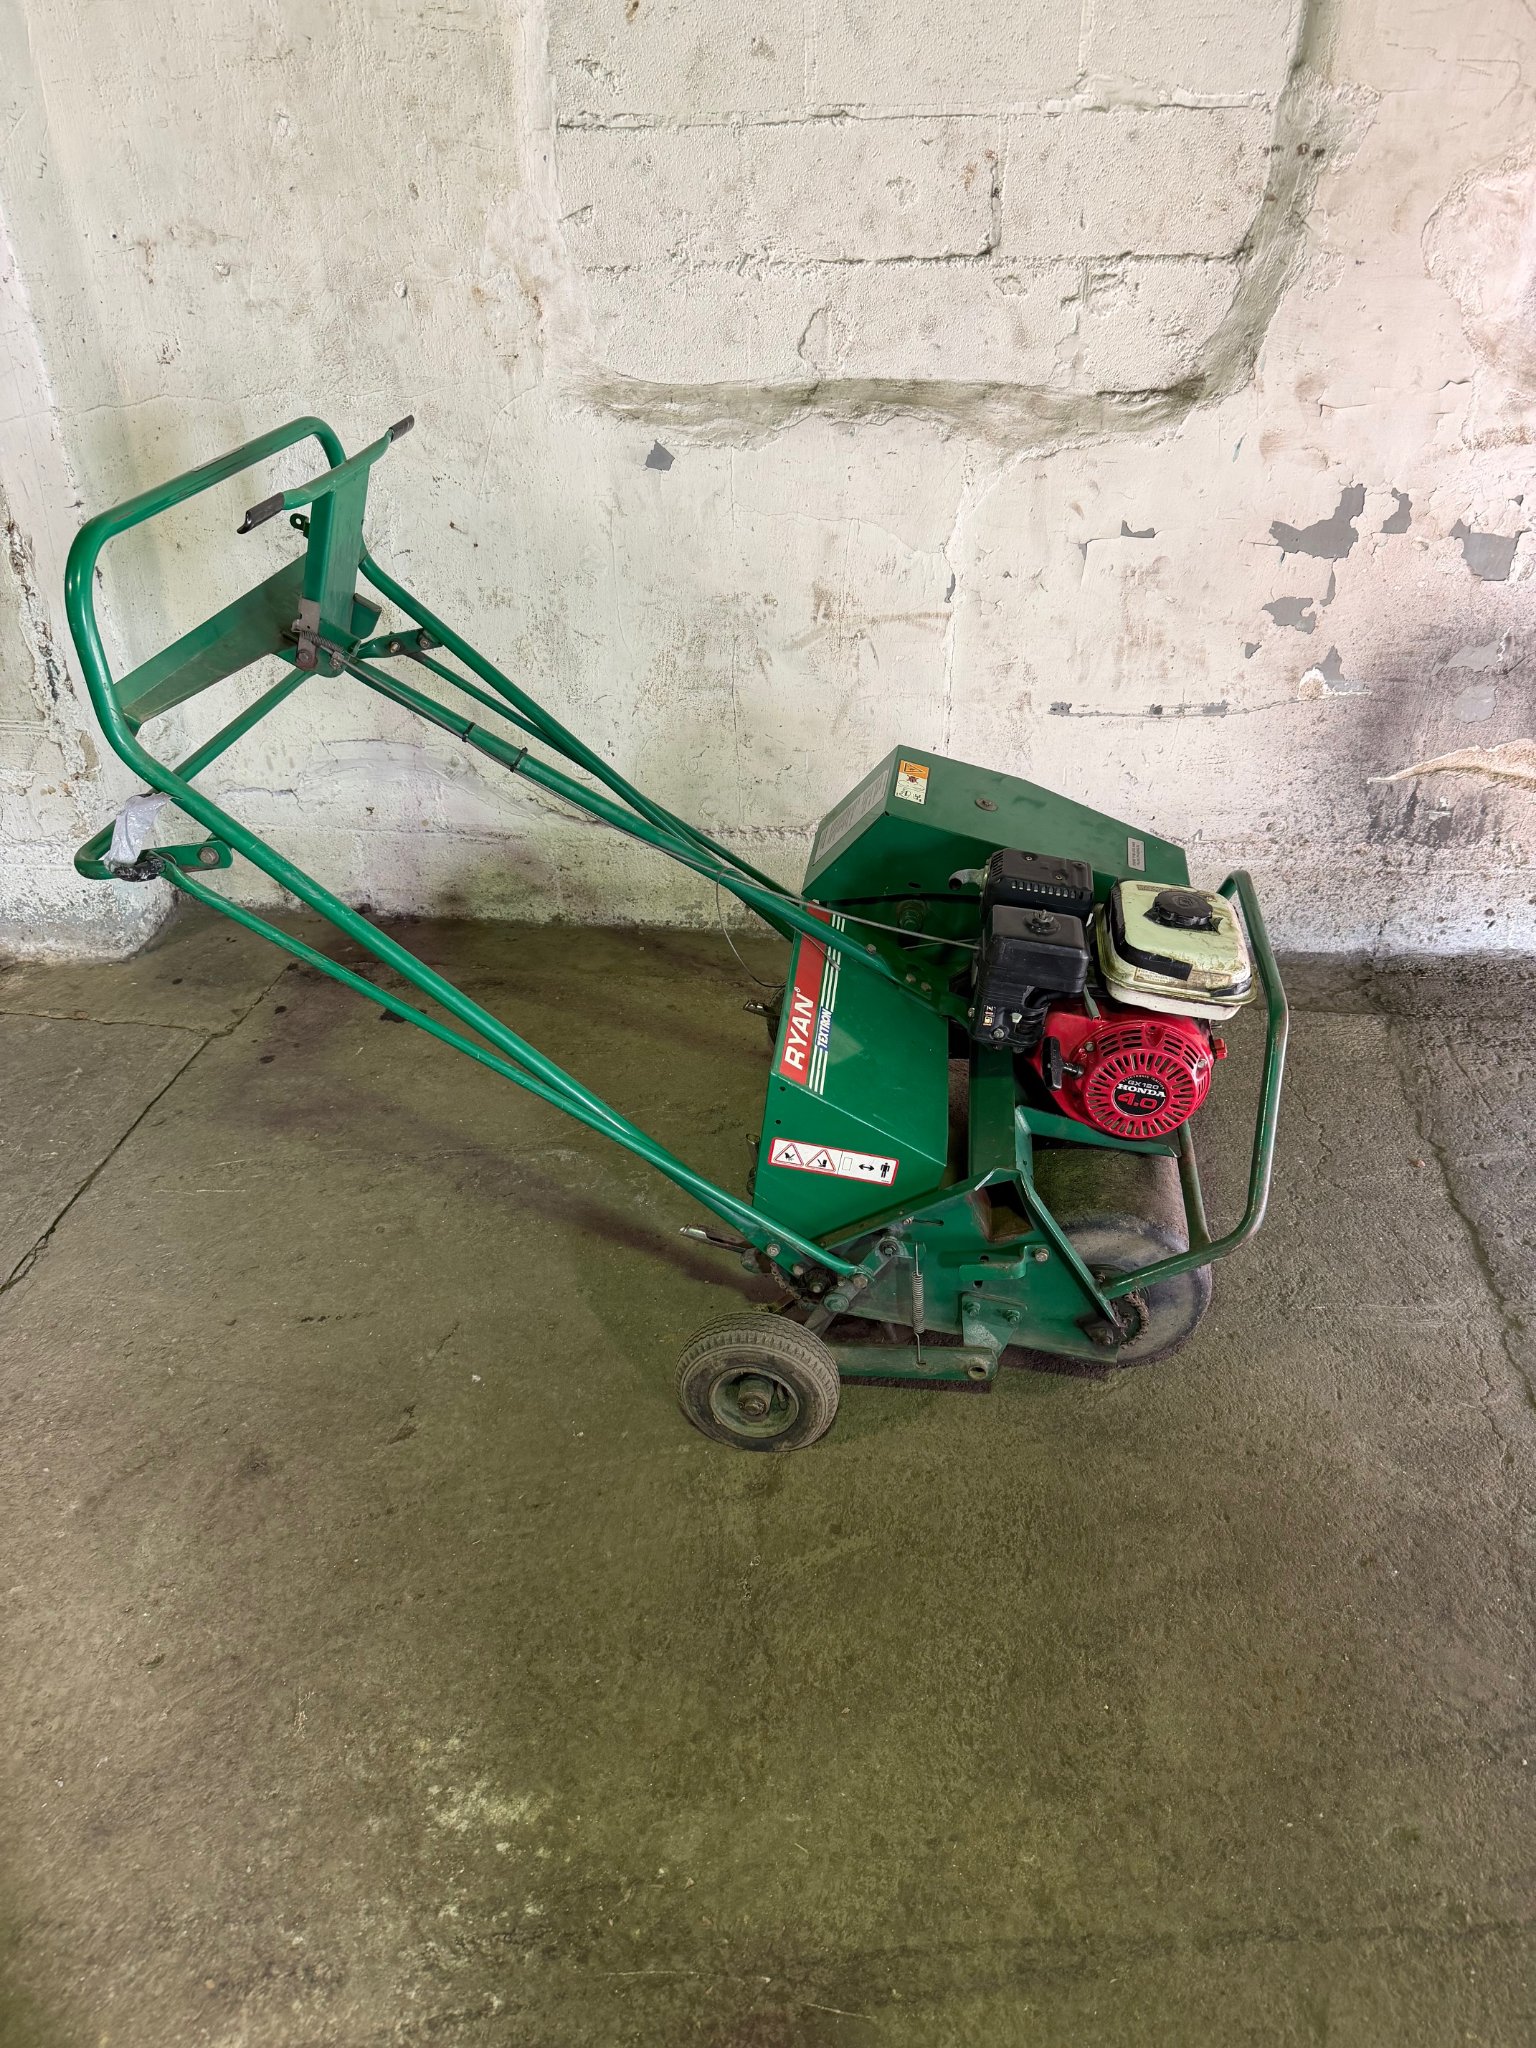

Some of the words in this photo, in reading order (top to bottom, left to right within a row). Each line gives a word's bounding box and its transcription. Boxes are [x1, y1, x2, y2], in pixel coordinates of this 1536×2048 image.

[817, 1008, 832, 1049] TEXTRON
[1116, 1083, 1166, 1098] HONDA
[1127, 1079, 1160, 1090] GX120
[1117, 1092, 1158, 1110] 4.0
